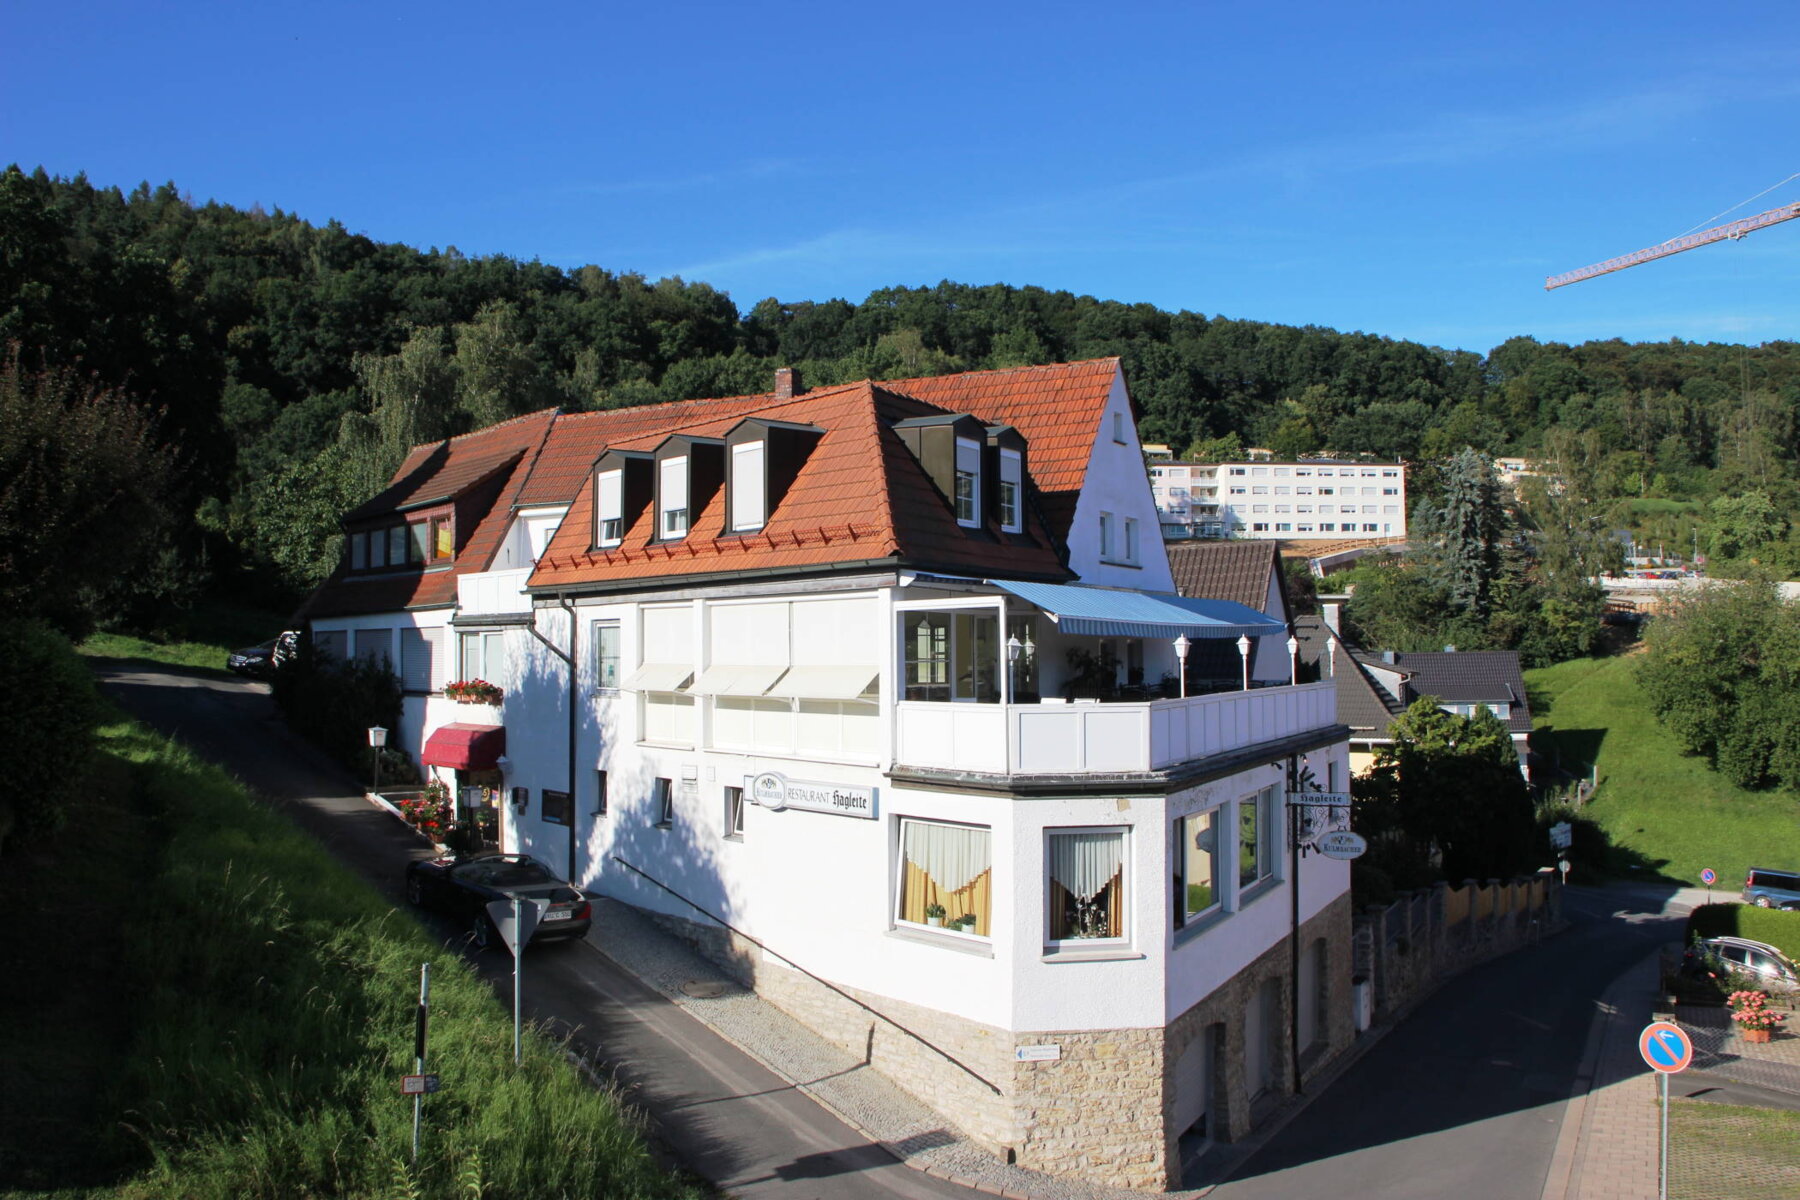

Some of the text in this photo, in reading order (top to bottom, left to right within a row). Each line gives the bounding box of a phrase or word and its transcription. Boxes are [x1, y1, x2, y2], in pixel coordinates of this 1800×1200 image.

[787, 788, 867, 809] RESTAURANT Hagleite
[1301, 794, 1342, 803] Hagleite
